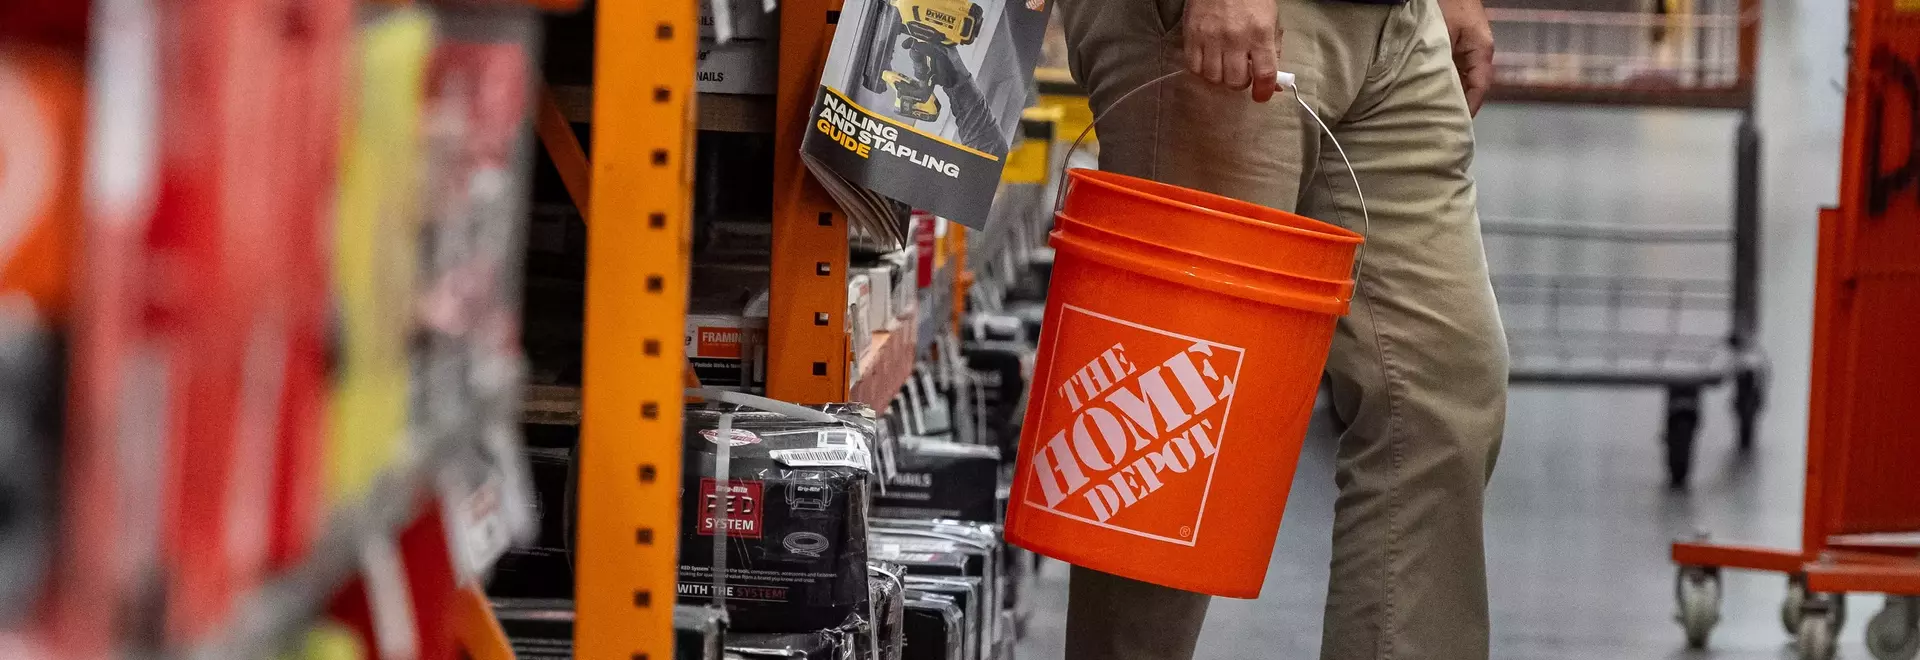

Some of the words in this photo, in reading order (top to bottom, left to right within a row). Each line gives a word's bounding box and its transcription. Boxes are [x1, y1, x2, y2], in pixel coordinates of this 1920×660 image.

[697, 71, 724, 82] NAILS
[817, 119, 872, 159] GUIDE
[824, 93, 899, 142] NAILING
[820, 107, 856, 137] AND
[858, 131, 961, 179] STAPLING
[702, 331, 745, 343] FRAMIN
[1058, 342, 1138, 414] THE
[1032, 340, 1235, 510] HOME
[1083, 418, 1217, 524] DEPOT
[705, 517, 754, 531] SYSTEM
[678, 583, 708, 595] WITH
[711, 585, 734, 597] THE
